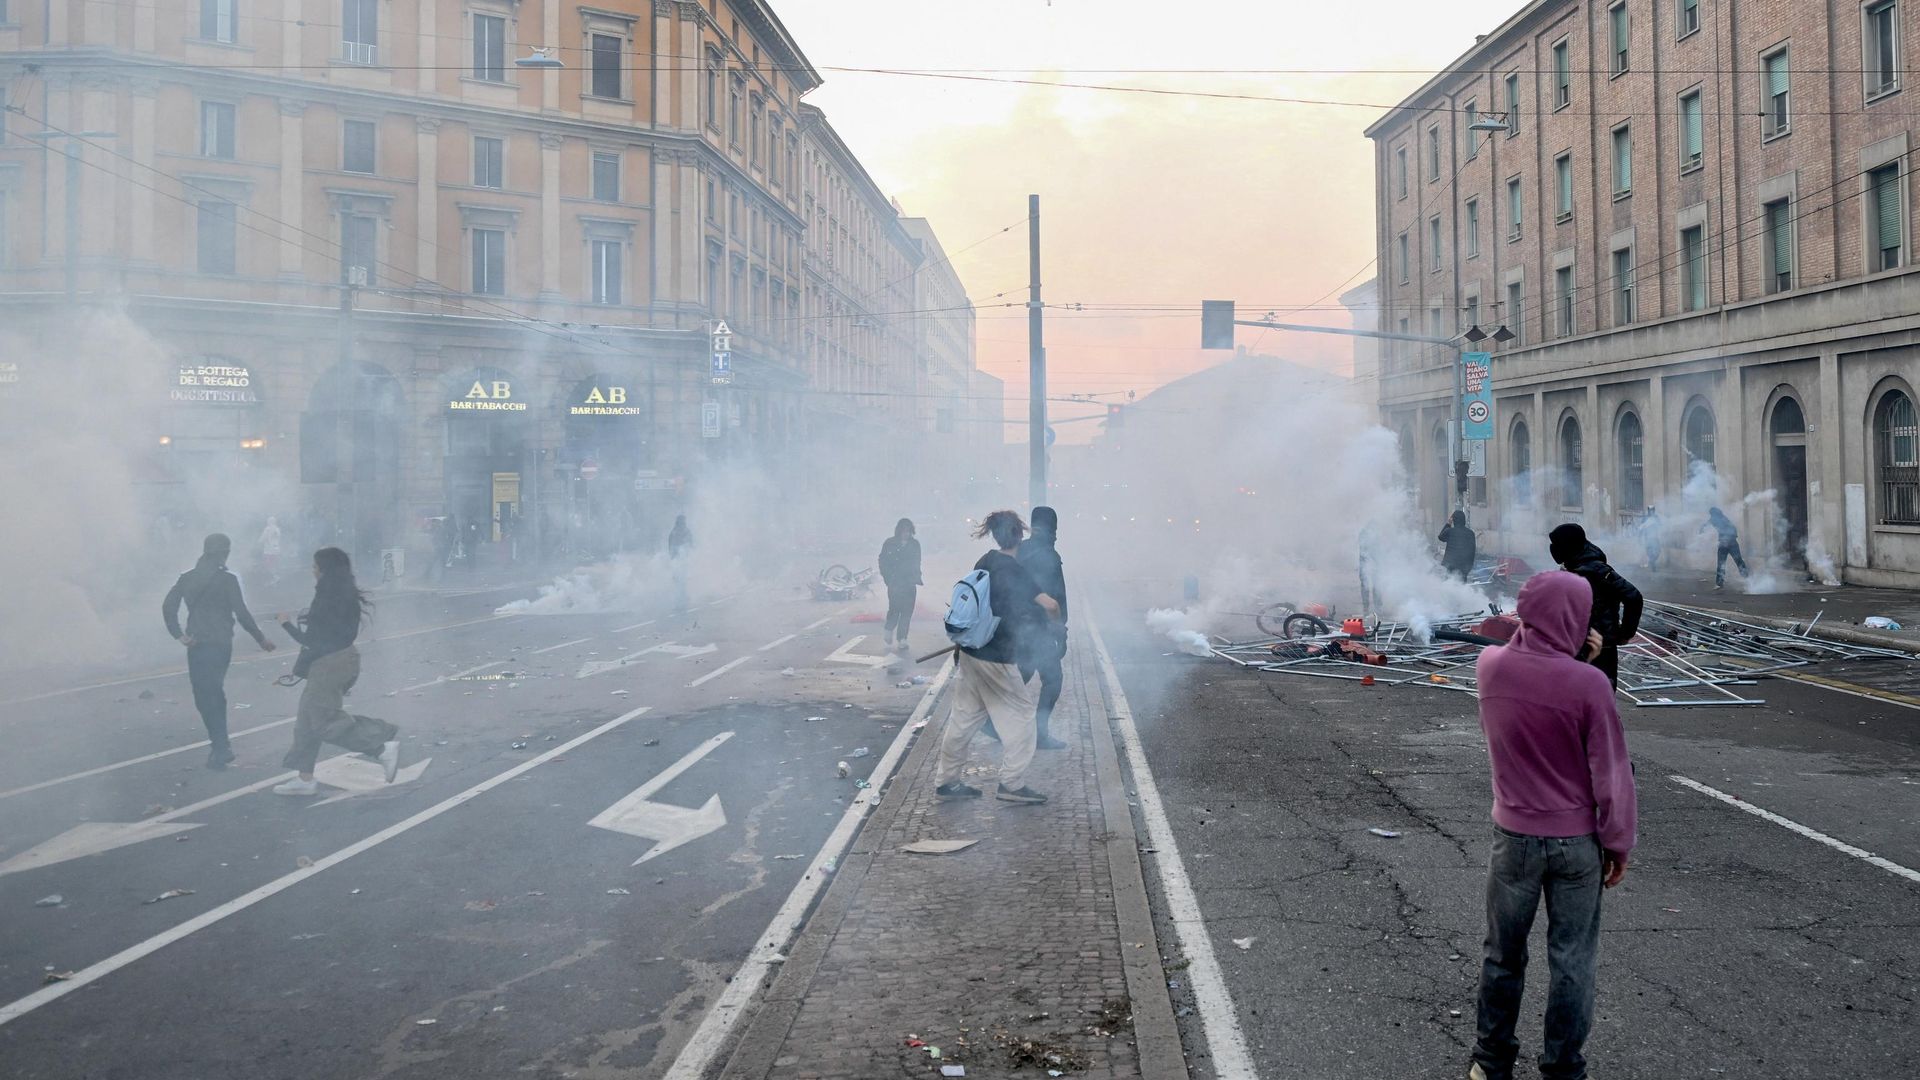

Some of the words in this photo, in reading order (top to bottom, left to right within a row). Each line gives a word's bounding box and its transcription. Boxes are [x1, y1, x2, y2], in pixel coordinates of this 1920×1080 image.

[180, 365, 195, 375] LA
[198, 366, 249, 376] BOTTEGA
[1466, 365, 1488, 373] PIANO
[1466, 371, 1489, 379] SALVA
[180, 376, 200, 385] DEL
[203, 376, 249, 387] REGALO
[465, 381, 511, 399] AB
[584, 386, 626, 404] AB
[1470, 407, 1486, 416] 30
